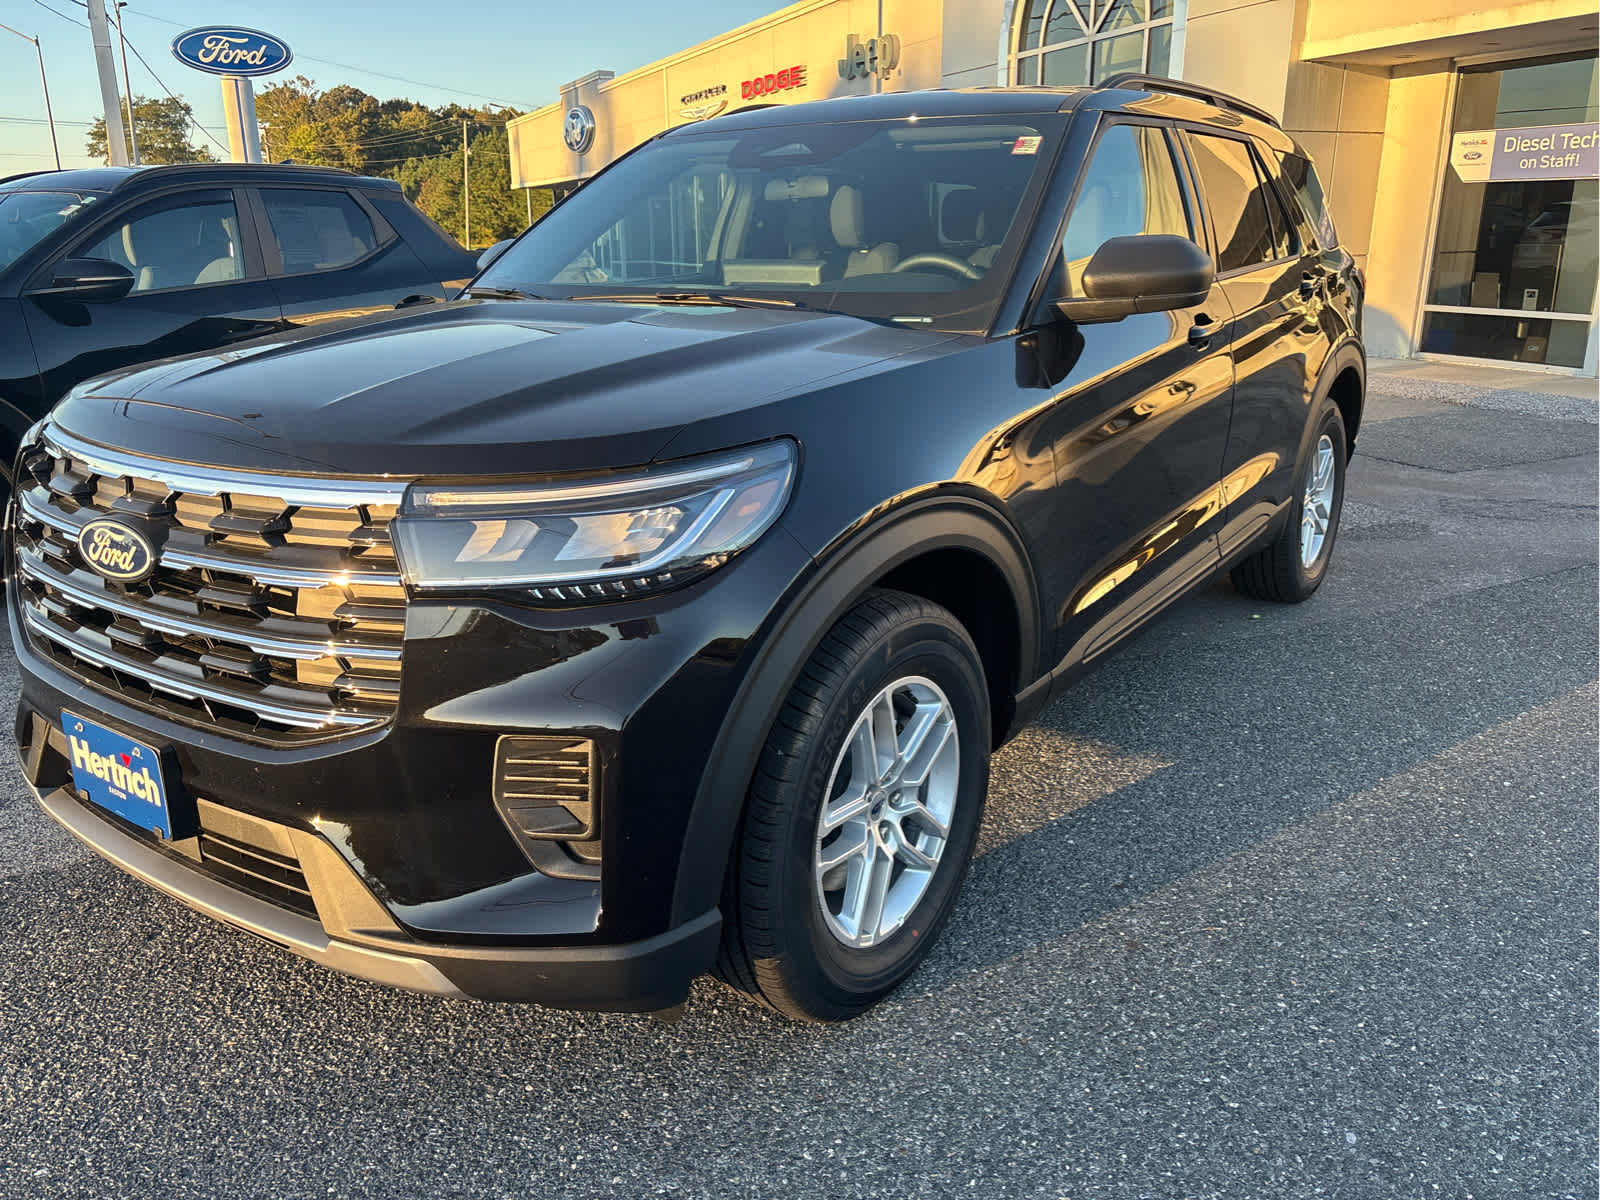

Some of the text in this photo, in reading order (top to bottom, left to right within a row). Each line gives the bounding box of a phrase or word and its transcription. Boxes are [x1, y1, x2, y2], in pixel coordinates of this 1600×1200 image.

[198, 35, 267, 65] Ford
[838, 34, 899, 80] Jeep
[741, 65, 803, 100] DODGE
[1504, 131, 1599, 152] Diesel Tech
[1520, 154, 1580, 169] on Staff!
[89, 527, 137, 571] Ford
[69, 735, 161, 807] Hertrich
